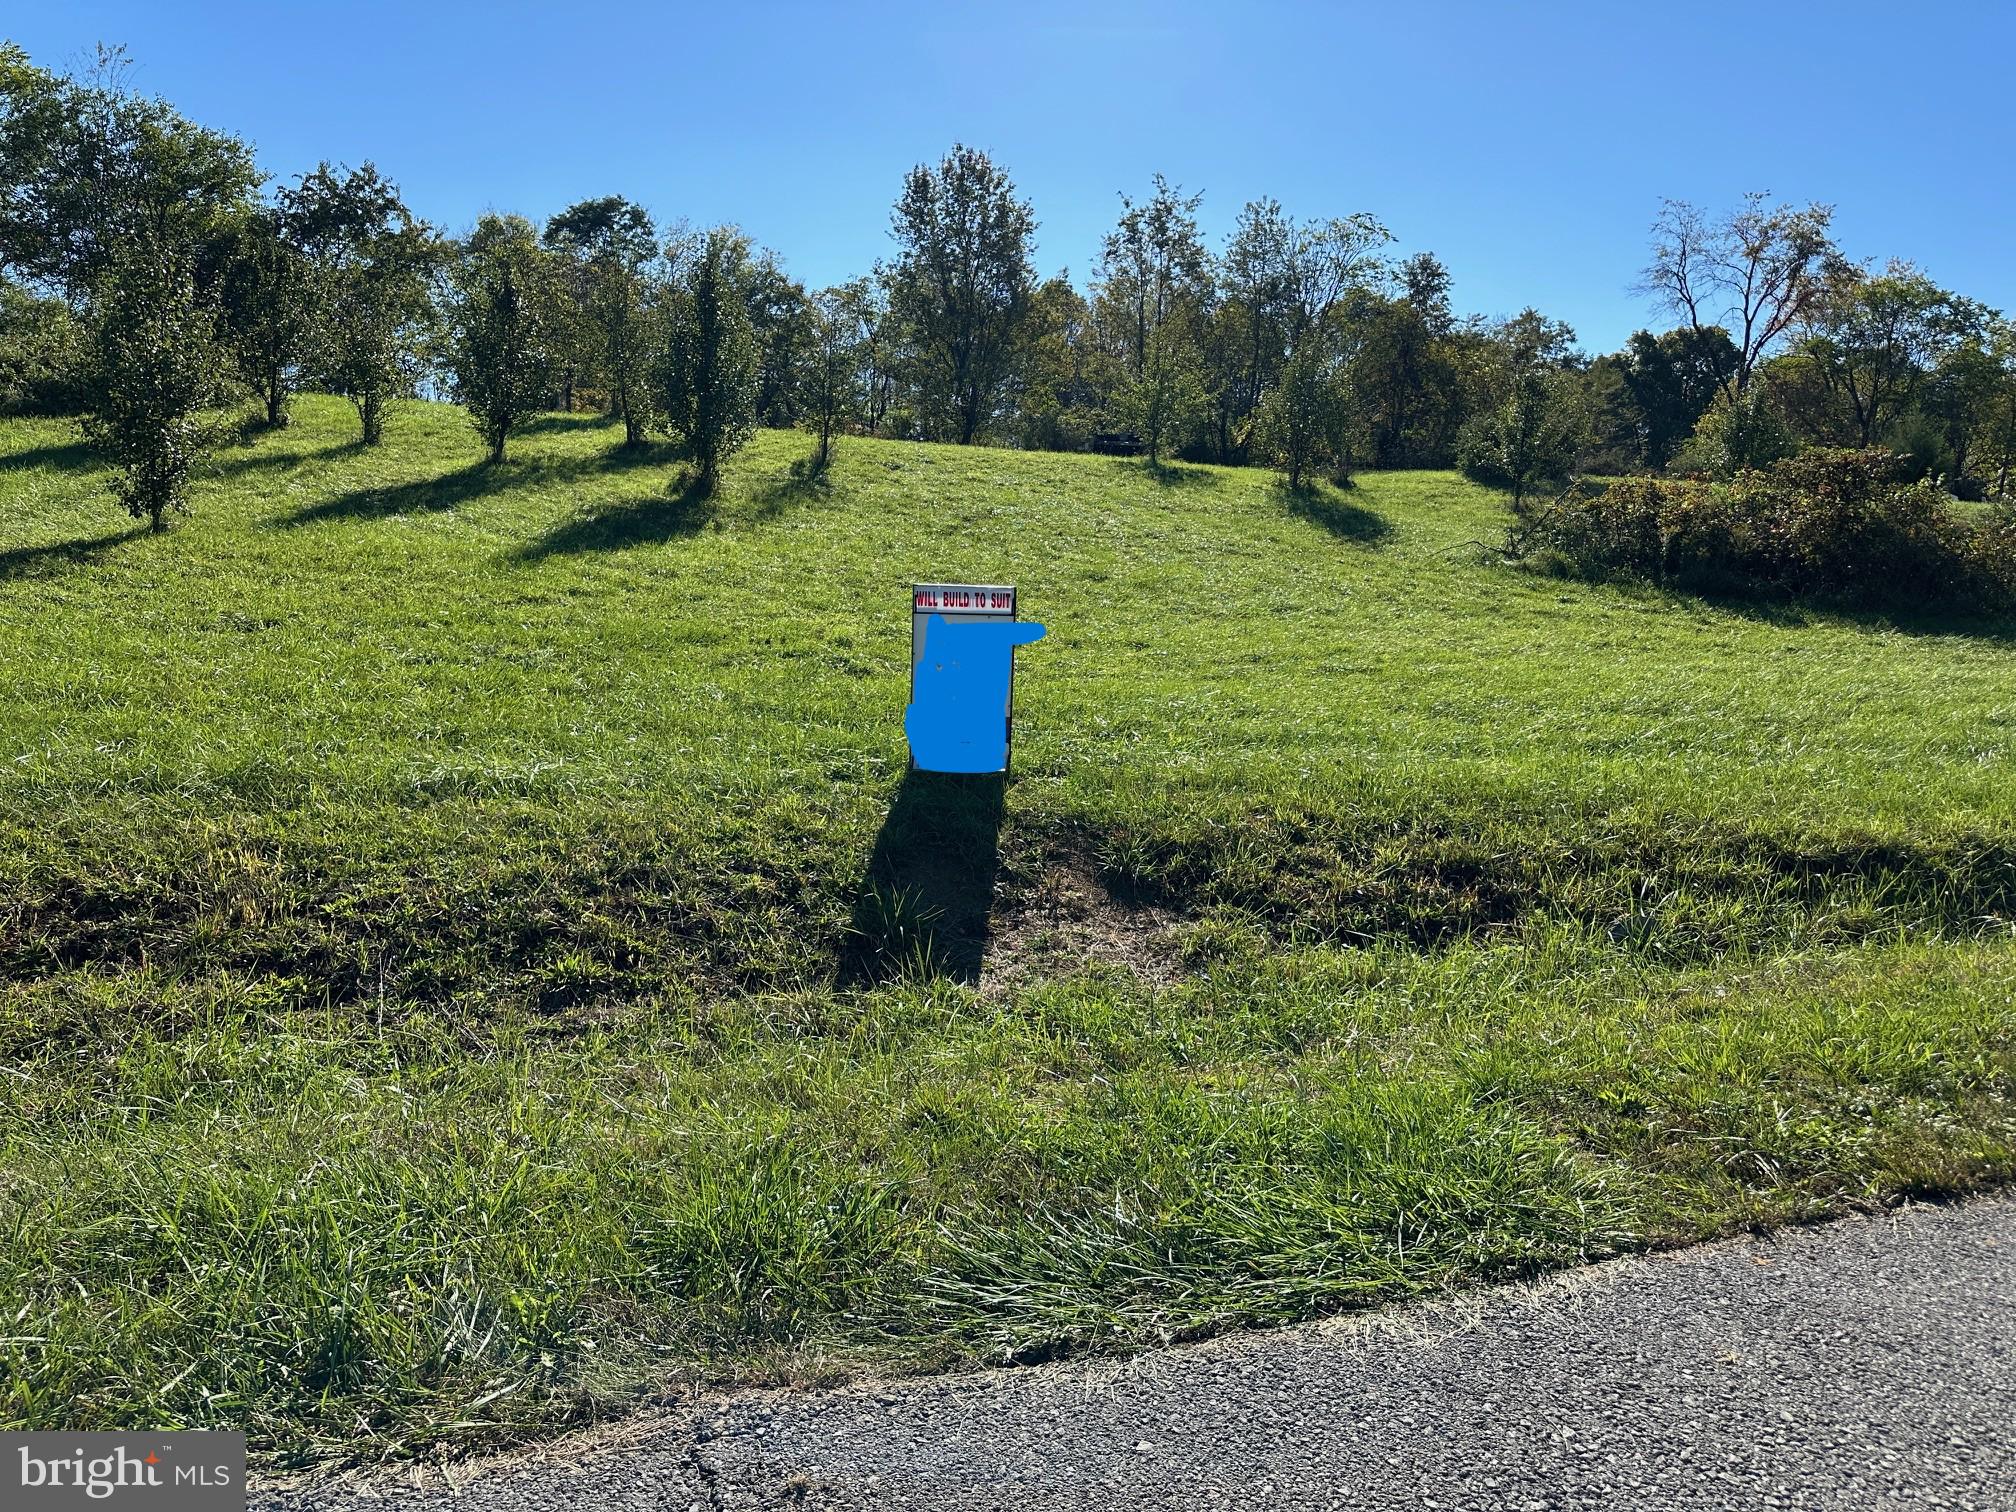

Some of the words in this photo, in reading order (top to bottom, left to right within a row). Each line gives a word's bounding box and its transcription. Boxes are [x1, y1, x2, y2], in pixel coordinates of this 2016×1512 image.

[916, 590, 938, 607] WILL
[943, 591, 970, 607] BUILD
[975, 592, 986, 608] TO
[991, 593, 1011, 608] SUIT
